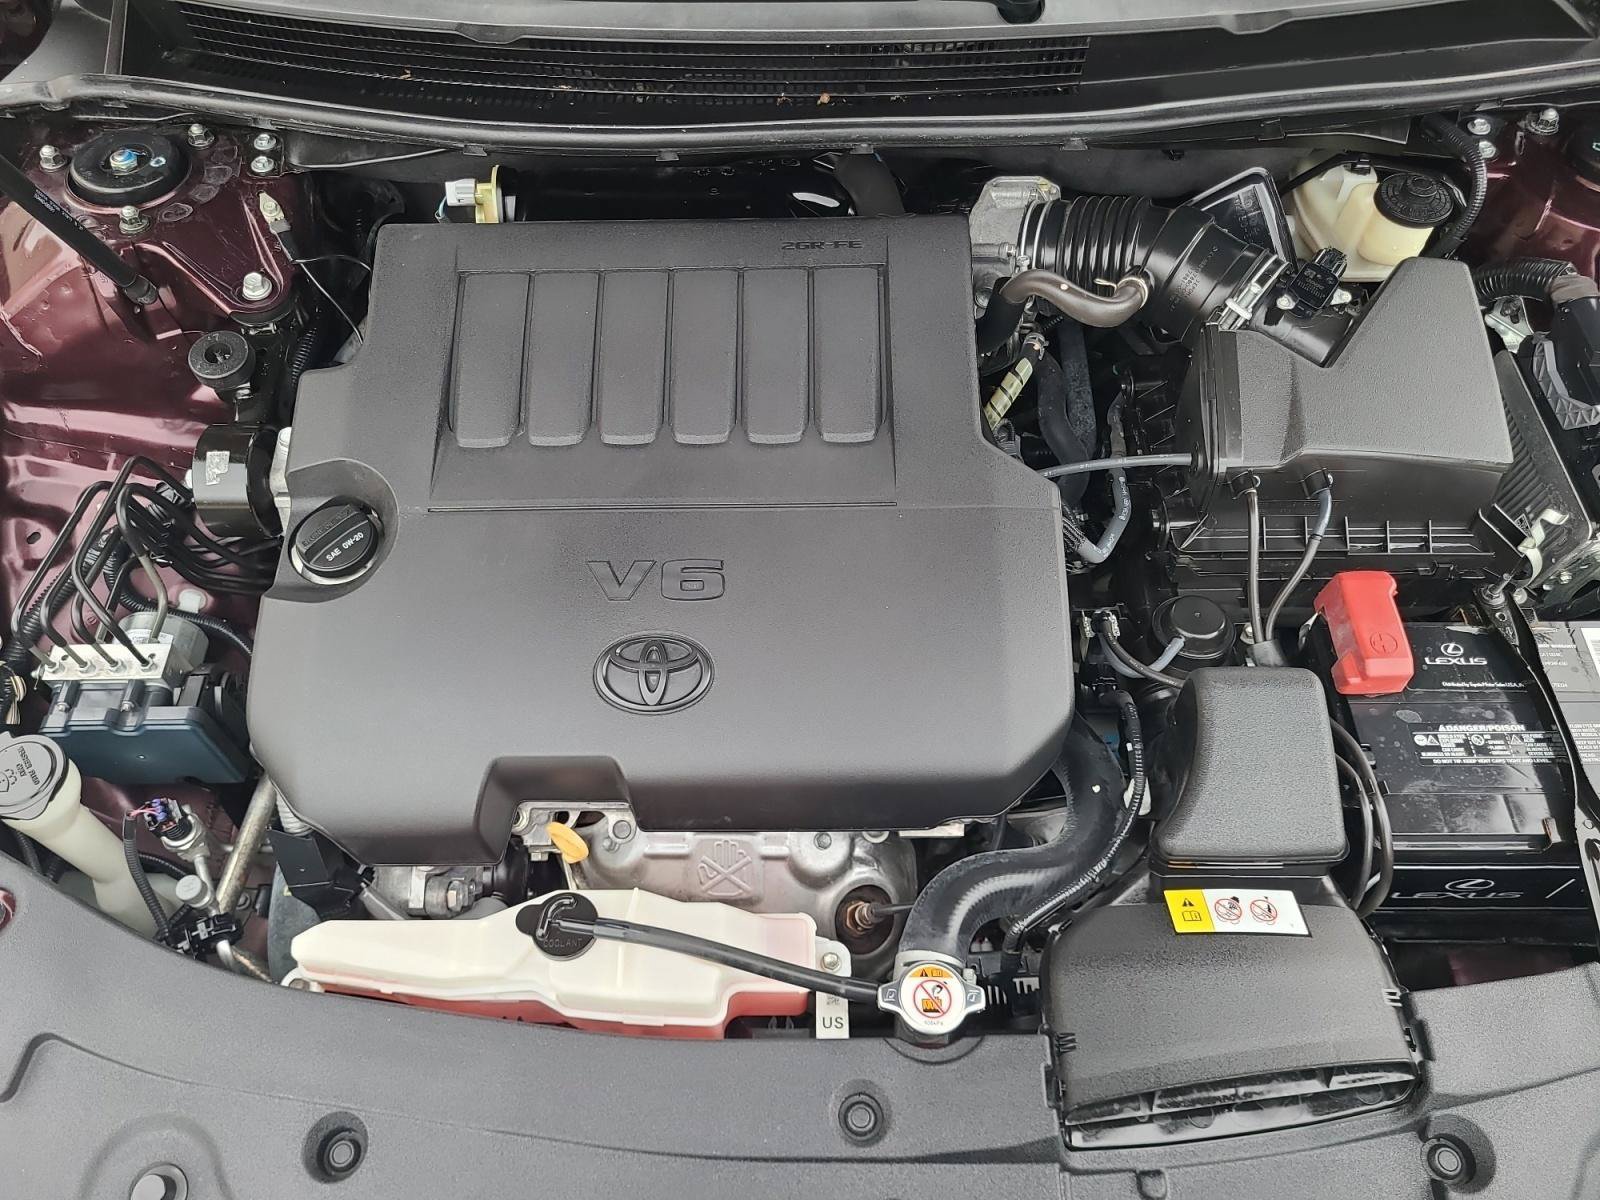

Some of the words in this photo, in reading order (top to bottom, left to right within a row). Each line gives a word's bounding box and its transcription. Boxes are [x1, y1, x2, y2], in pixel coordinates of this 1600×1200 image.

[780, 239, 864, 250] 2GR-FE
[326, 547, 342, 562] SAE
[341, 531, 364, 549] 0W-20
[585, 558, 725, 602] V6
[1424, 656, 1488, 666] LEXUS
[1391, 891, 1524, 899] LEXUS
[543, 938, 582, 948] COOLANT
[822, 1016, 844, 1030] US
